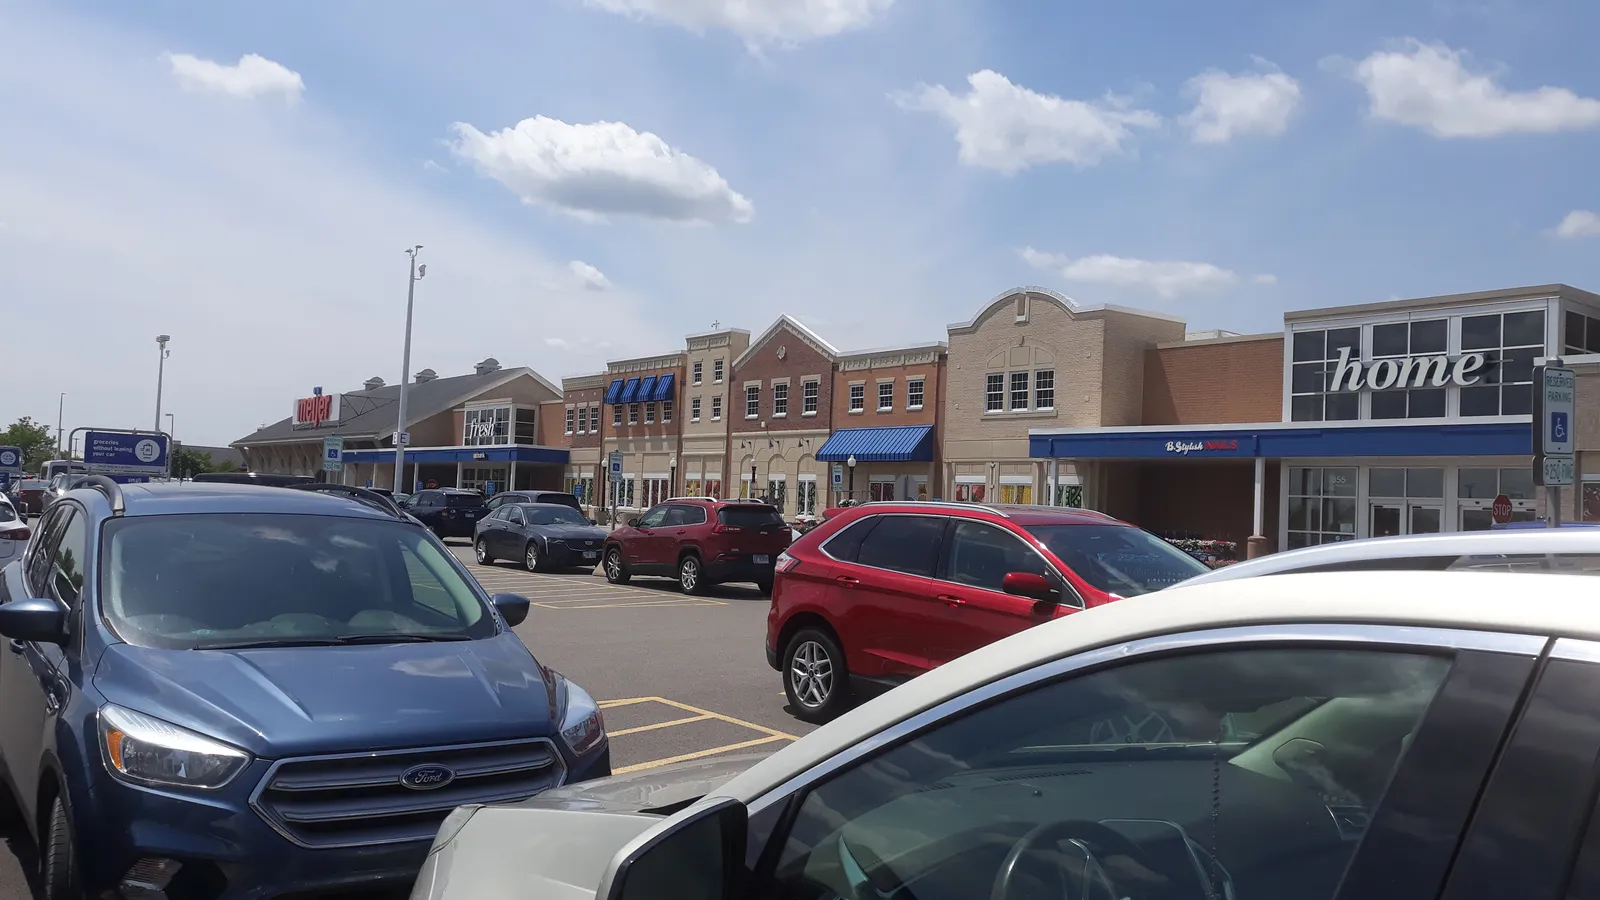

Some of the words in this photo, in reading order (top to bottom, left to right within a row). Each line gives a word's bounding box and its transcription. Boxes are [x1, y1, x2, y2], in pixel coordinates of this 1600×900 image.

[1330, 346, 1485, 392] home
[1546, 375, 1574, 388] RESERVED
[1547, 390, 1572, 403] PARKING
[297, 387, 332, 430] meijer
[469, 417, 495, 439] fresh
[400, 433, 408, 444] E
[1164, 441, 1204, 455] B.Stylish
[1205, 440, 1238, 450] NAILS
[1544, 463, 1561, 480] $250
[1561, 463, 1574, 480] FINE
[1494, 504, 1512, 516] STOP
[414, 769, 443, 784] Ford
